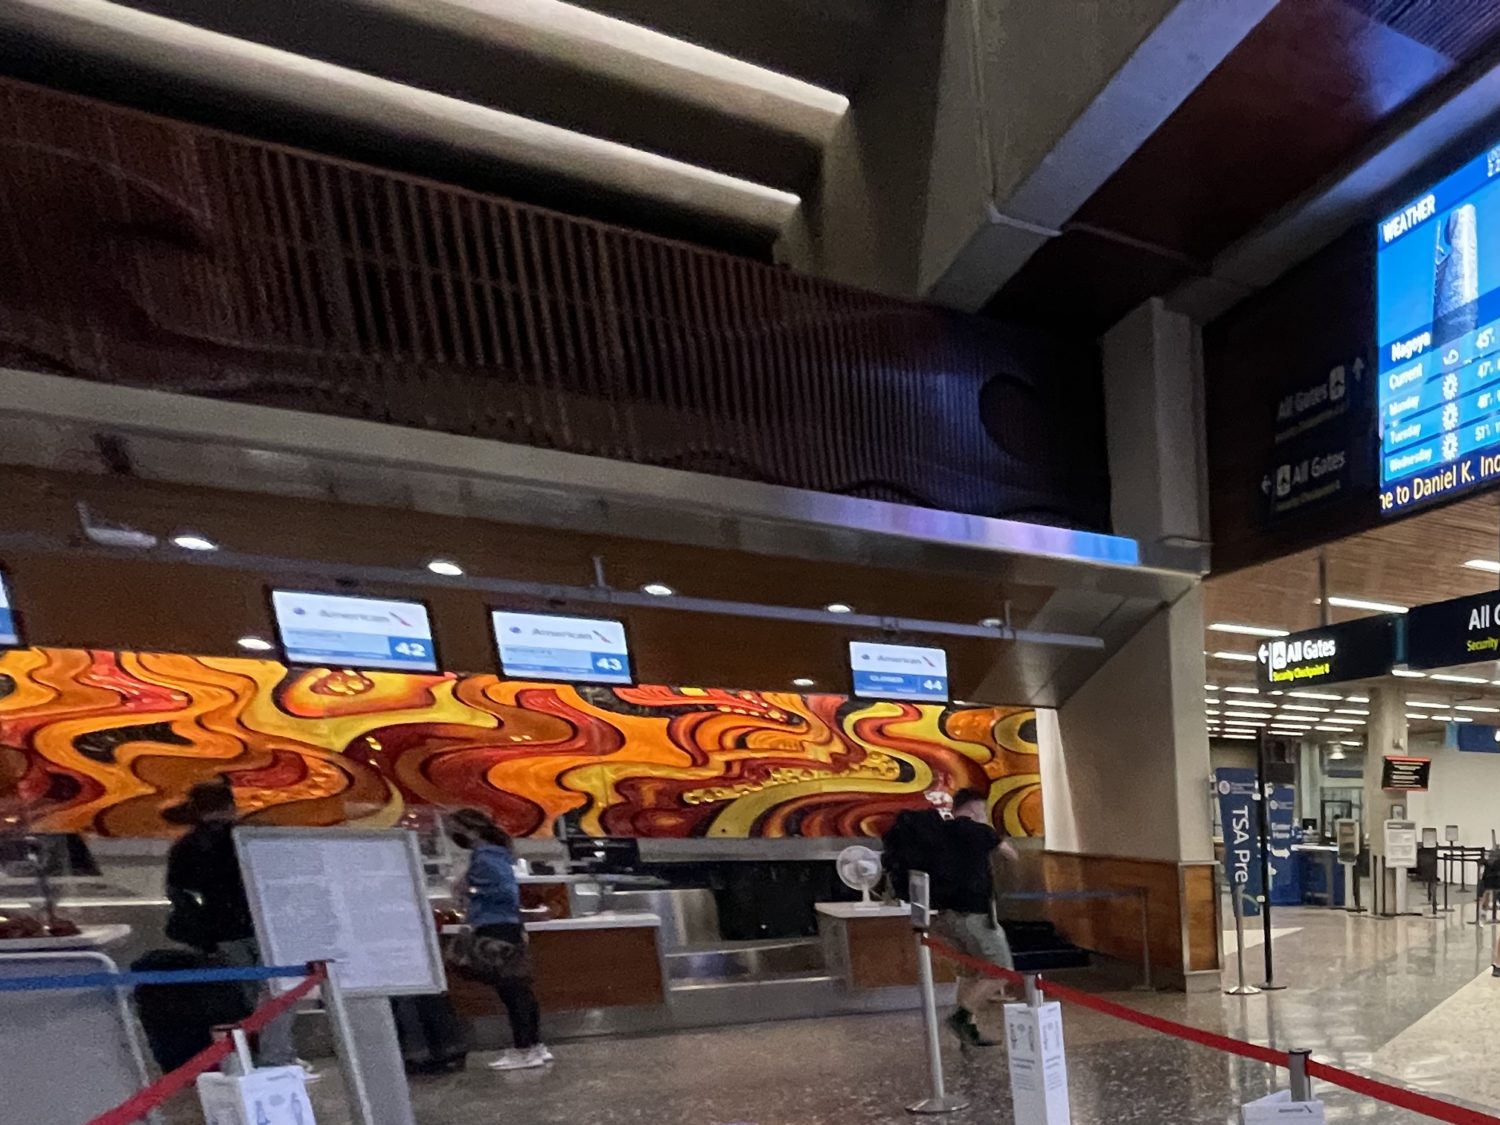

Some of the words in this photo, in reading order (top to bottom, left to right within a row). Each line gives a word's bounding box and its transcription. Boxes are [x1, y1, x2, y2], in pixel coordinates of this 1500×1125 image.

[1382, 193, 1436, 243] WEATHER
[1391, 331, 1431, 362] Nagoya
[1395, 482, 1410, 507] to
[1413, 465, 1458, 500] Daniel
[1461, 460, 1475, 484] K.
[1468, 604, 1490, 631] All
[395, 641, 426, 657] 42
[1287, 641, 1302, 663] All
[1303, 639, 1336, 660] Gates
[1467, 636, 1499, 652] Security
[596, 657, 623, 672] 43
[923, 679, 943, 691] 44
[1231, 805, 1250, 845] TSA
